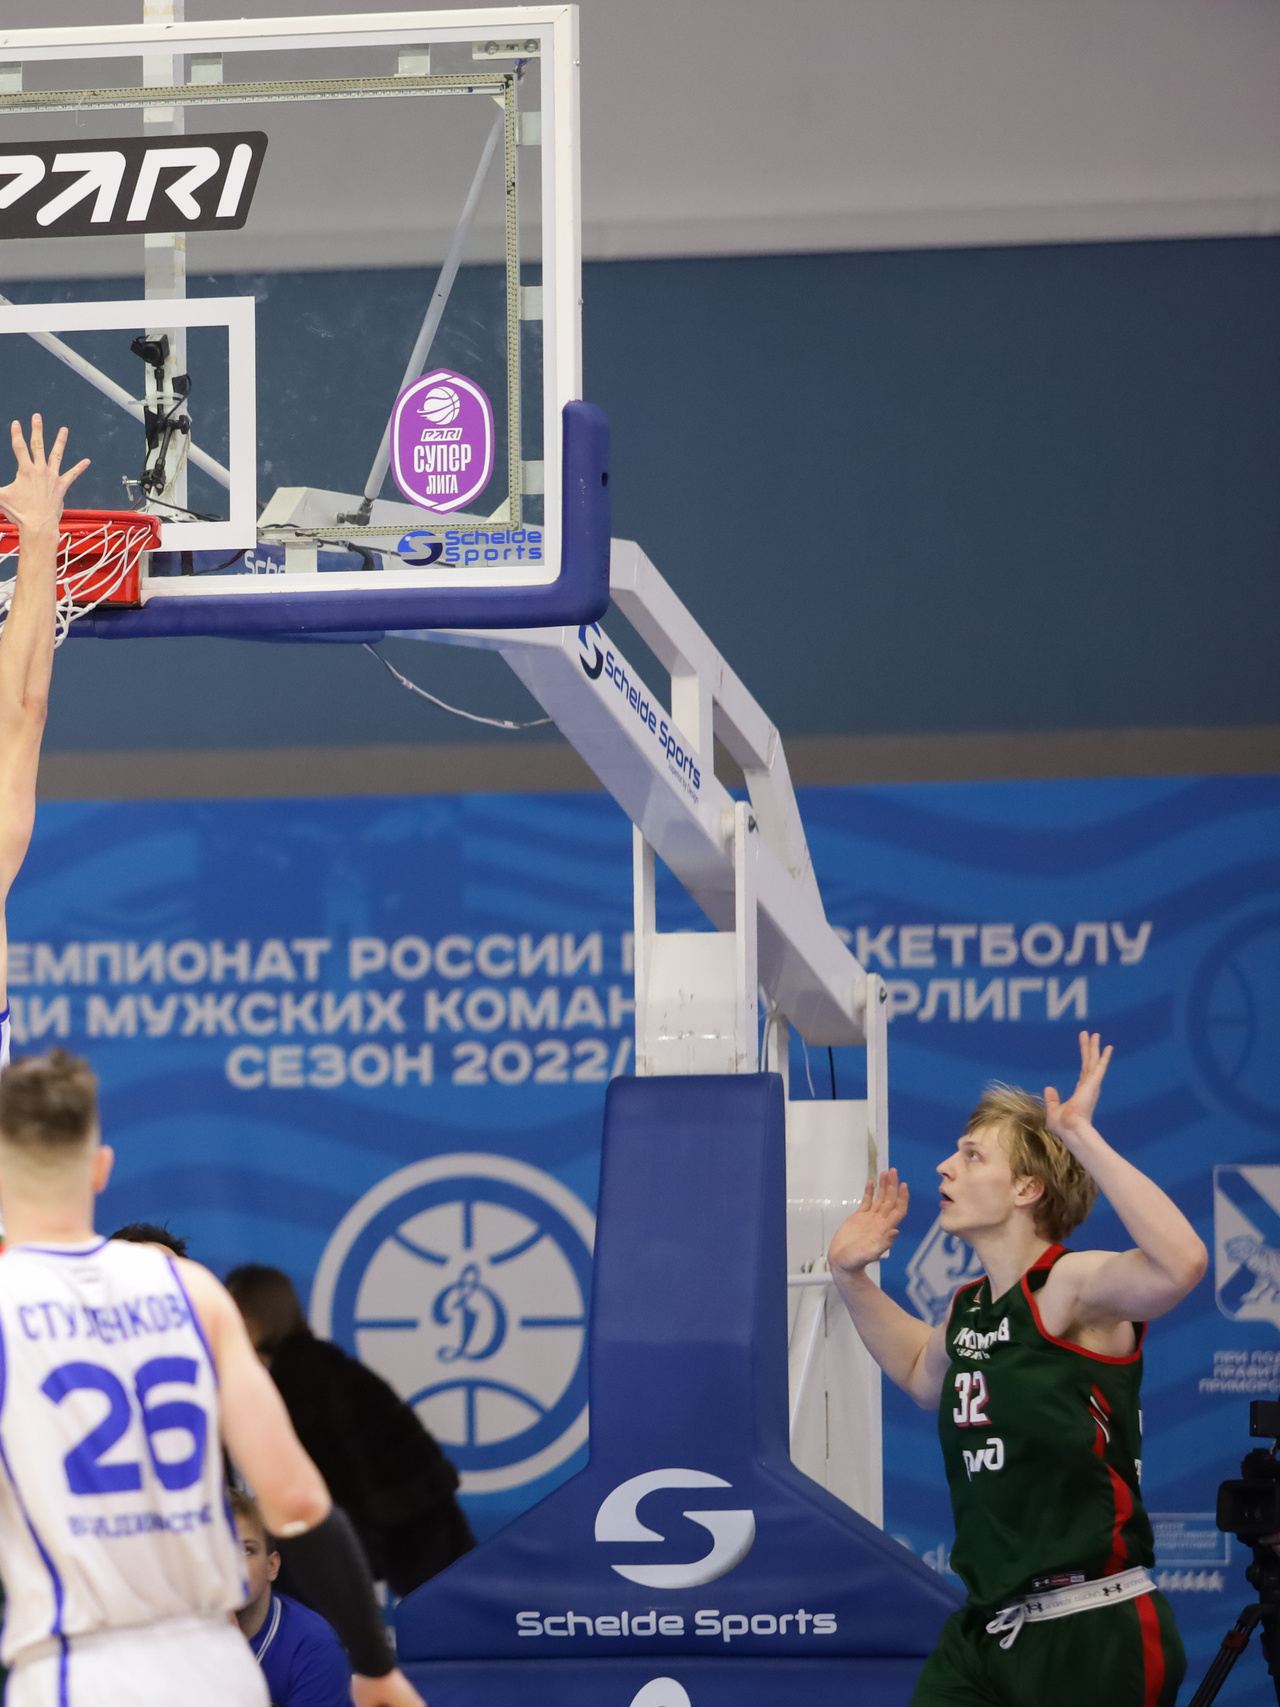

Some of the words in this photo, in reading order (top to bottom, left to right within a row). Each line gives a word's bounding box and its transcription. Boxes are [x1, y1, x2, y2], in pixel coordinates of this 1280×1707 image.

[424, 429, 461, 440] PARI
[413, 444, 471, 473] СУПЕР
[426, 475, 458, 495] ЛИГА
[444, 528, 542, 546] Schelde
[444, 544, 542, 565] Sports
[604, 650, 657, 735] Schelde
[658, 720, 701, 790] Sports
[349, 933, 603, 980] РОССИИ
[86, 989, 407, 1037] МУЖСКИХ
[226, 1043, 435, 1090] СЕЗОН
[953, 1371, 992, 1427] 32
[40, 1356, 207, 1497] 26
[516, 1609, 685, 1637] Schelde
[695, 1608, 837, 1642] Sports
